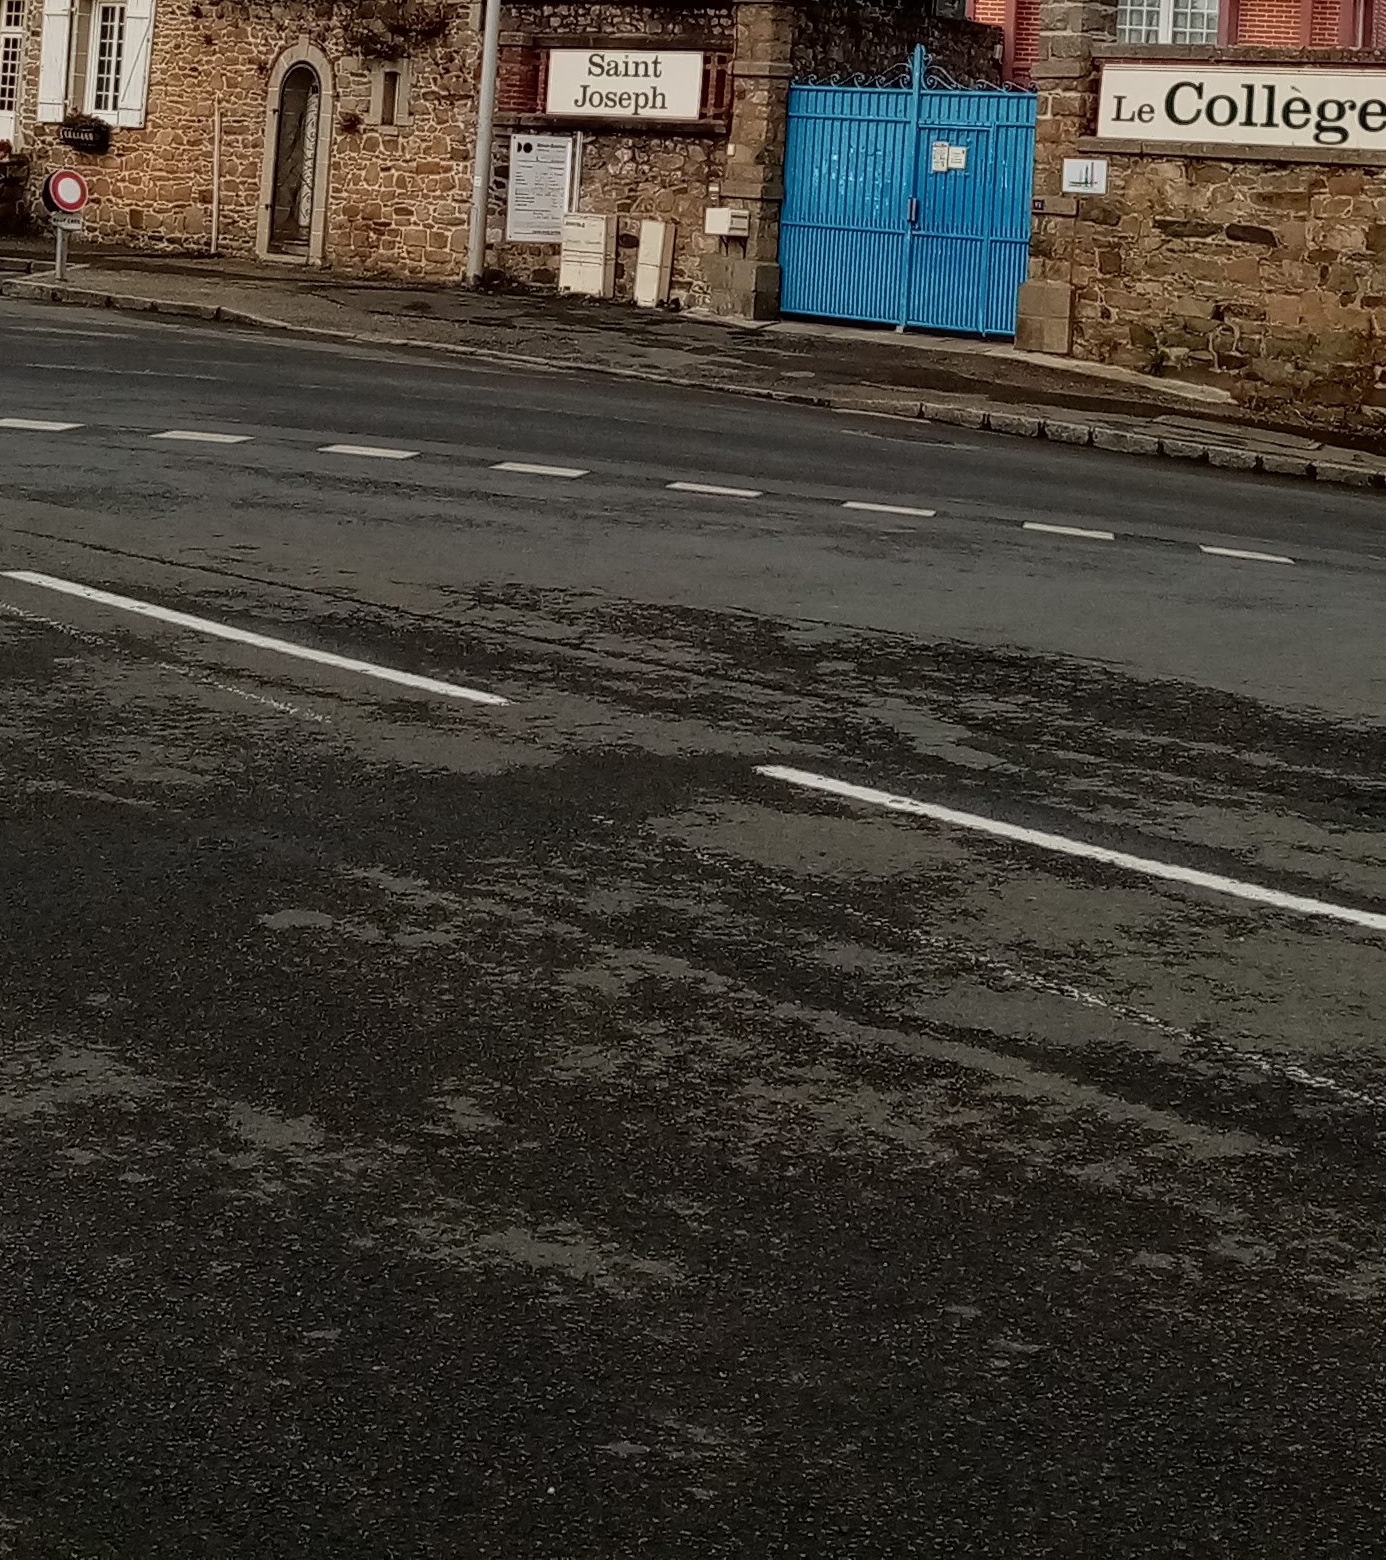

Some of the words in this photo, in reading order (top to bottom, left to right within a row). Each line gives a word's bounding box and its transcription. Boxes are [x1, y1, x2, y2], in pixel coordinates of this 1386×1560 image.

[587, 53, 662, 79] Saint
[574, 85, 668, 115] Joseph
[1111, 95, 1155, 123] Le
